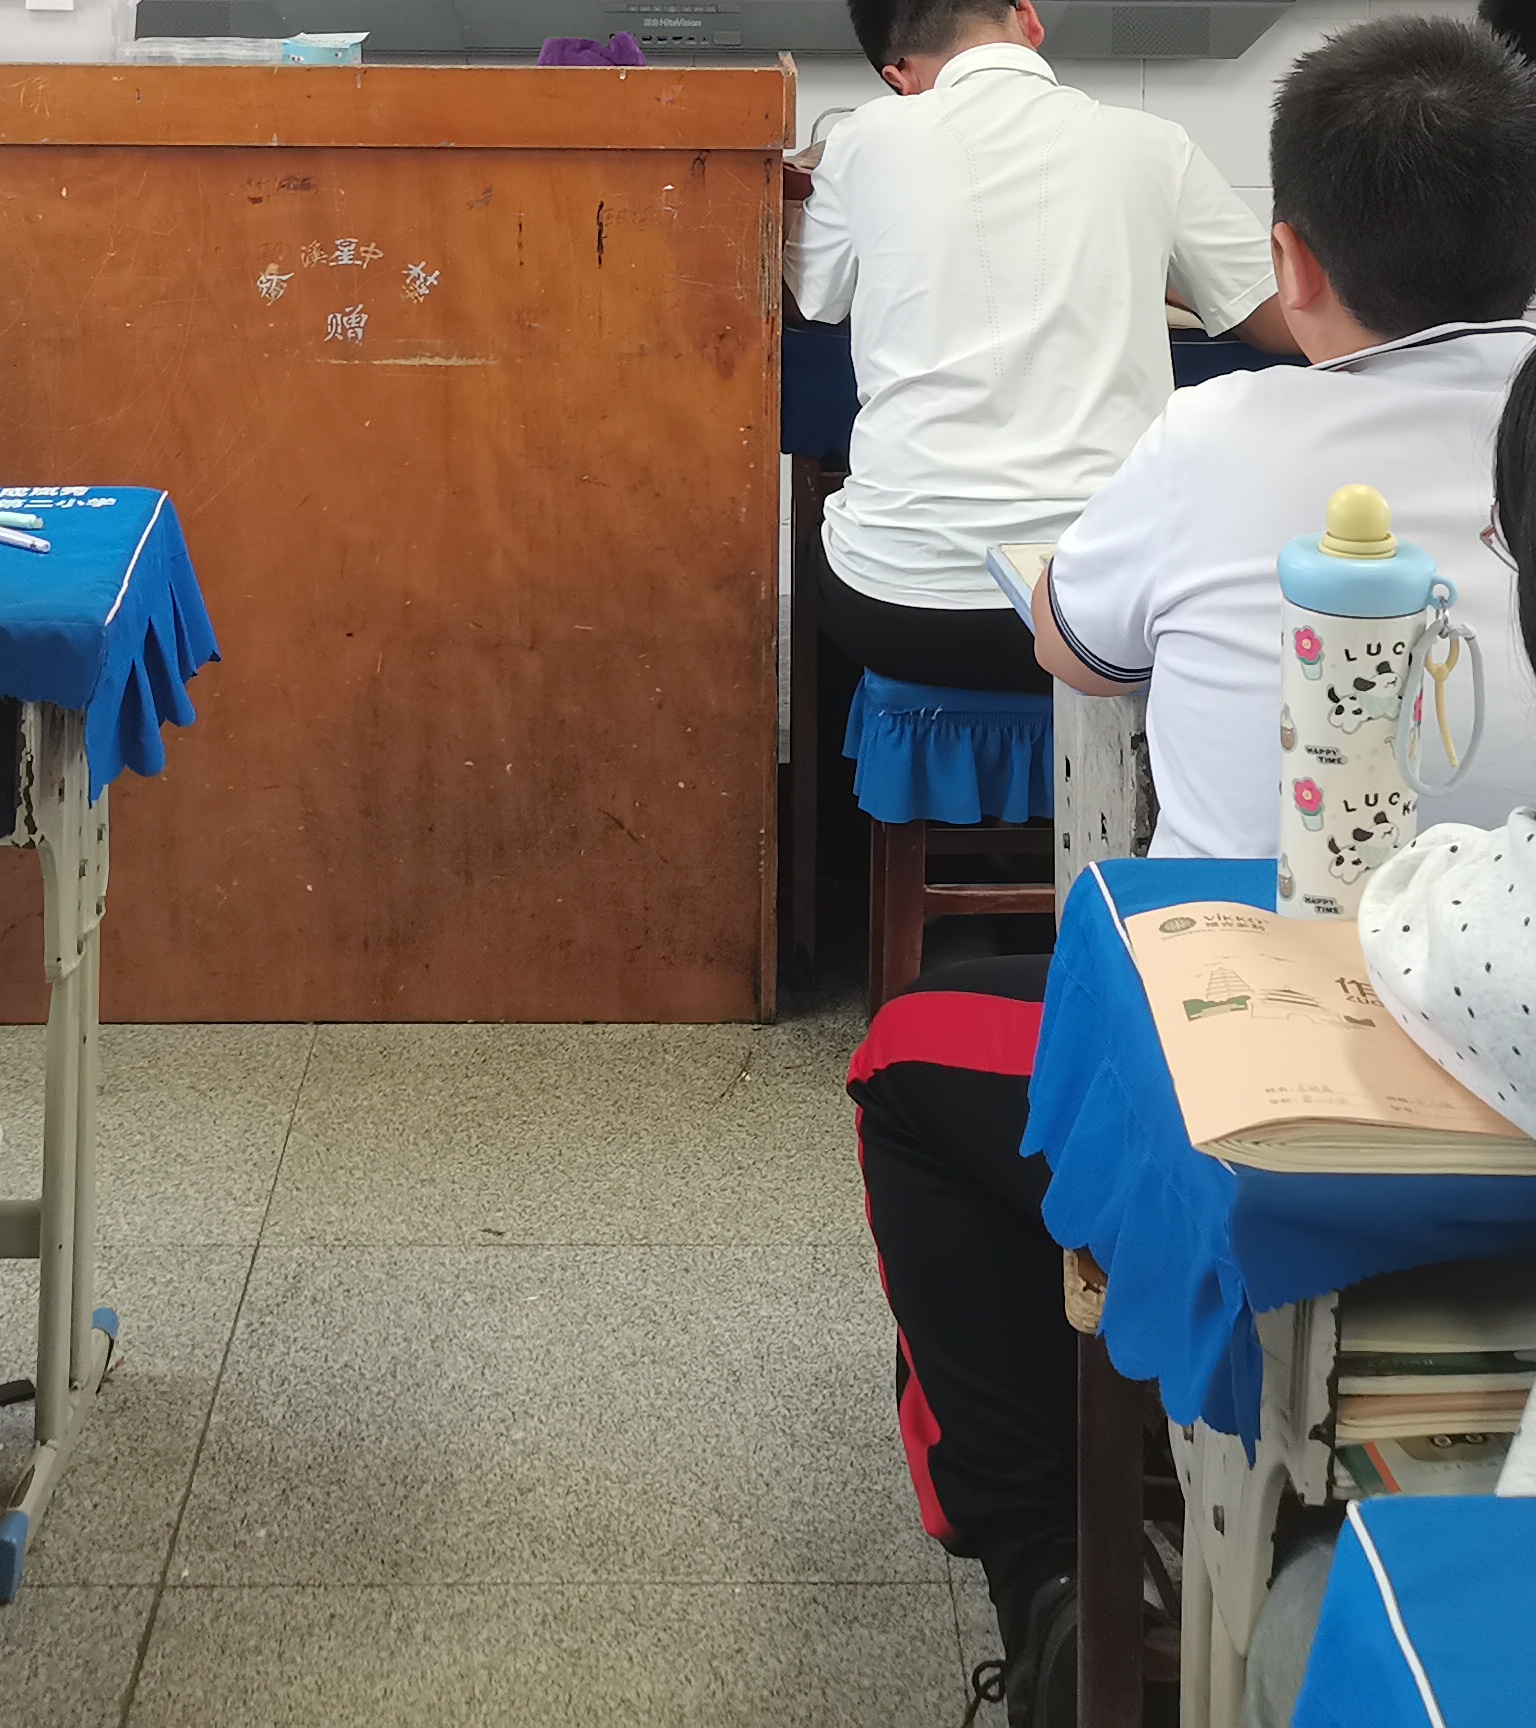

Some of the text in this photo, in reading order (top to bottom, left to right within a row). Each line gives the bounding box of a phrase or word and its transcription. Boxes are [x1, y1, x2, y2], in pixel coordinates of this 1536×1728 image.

[1306, 747, 1339, 756] HAPPY
[1318, 756, 1343, 765] TIME
[1316, 905, 1340, 915] TIME
